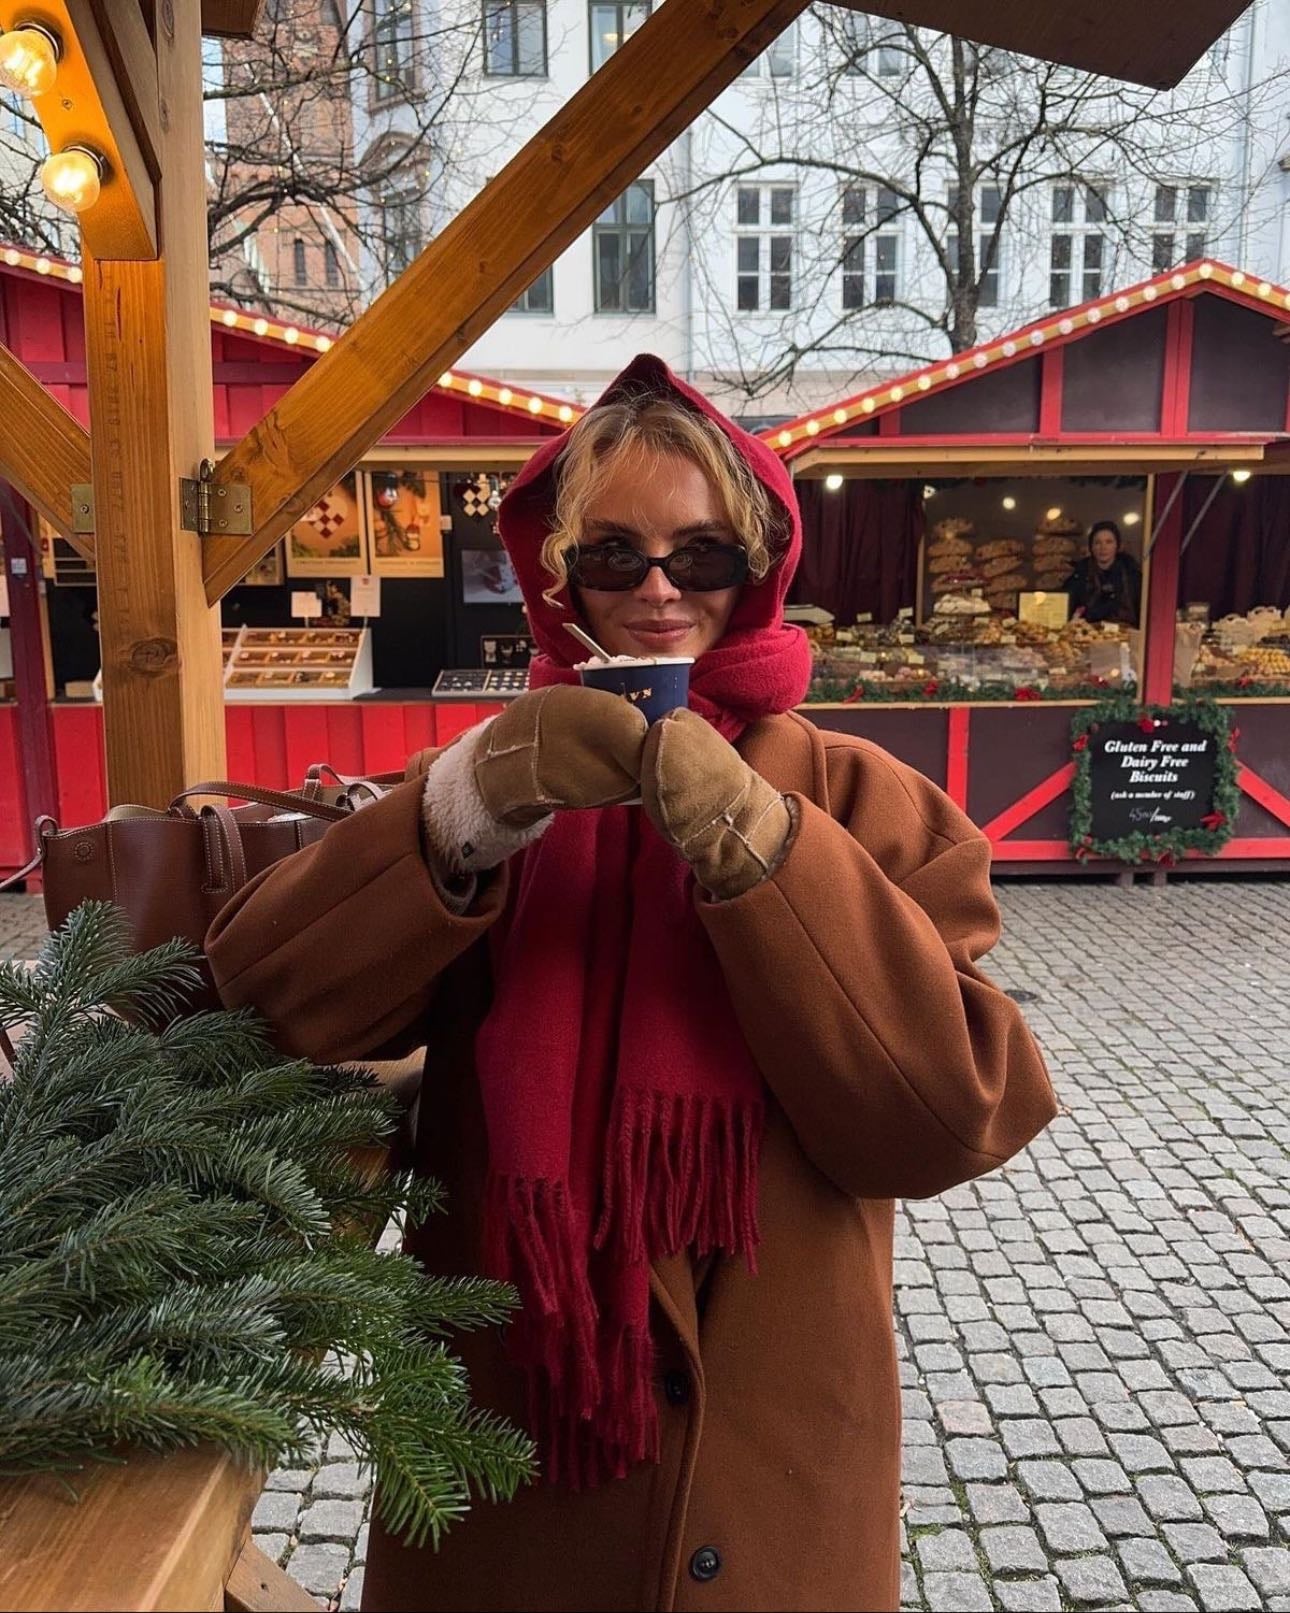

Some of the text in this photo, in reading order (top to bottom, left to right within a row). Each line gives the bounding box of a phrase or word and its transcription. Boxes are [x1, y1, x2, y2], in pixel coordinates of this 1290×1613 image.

[1104, 739, 1207, 753] Gluten Free and
[1120, 755, 1189, 771] Dairy Free
[1129, 770, 1179, 784] Biscuits
[1134, 790, 1162, 799] member
[1162, 790, 1173, 801] of
[1173, 790, 1196, 801] staff)
